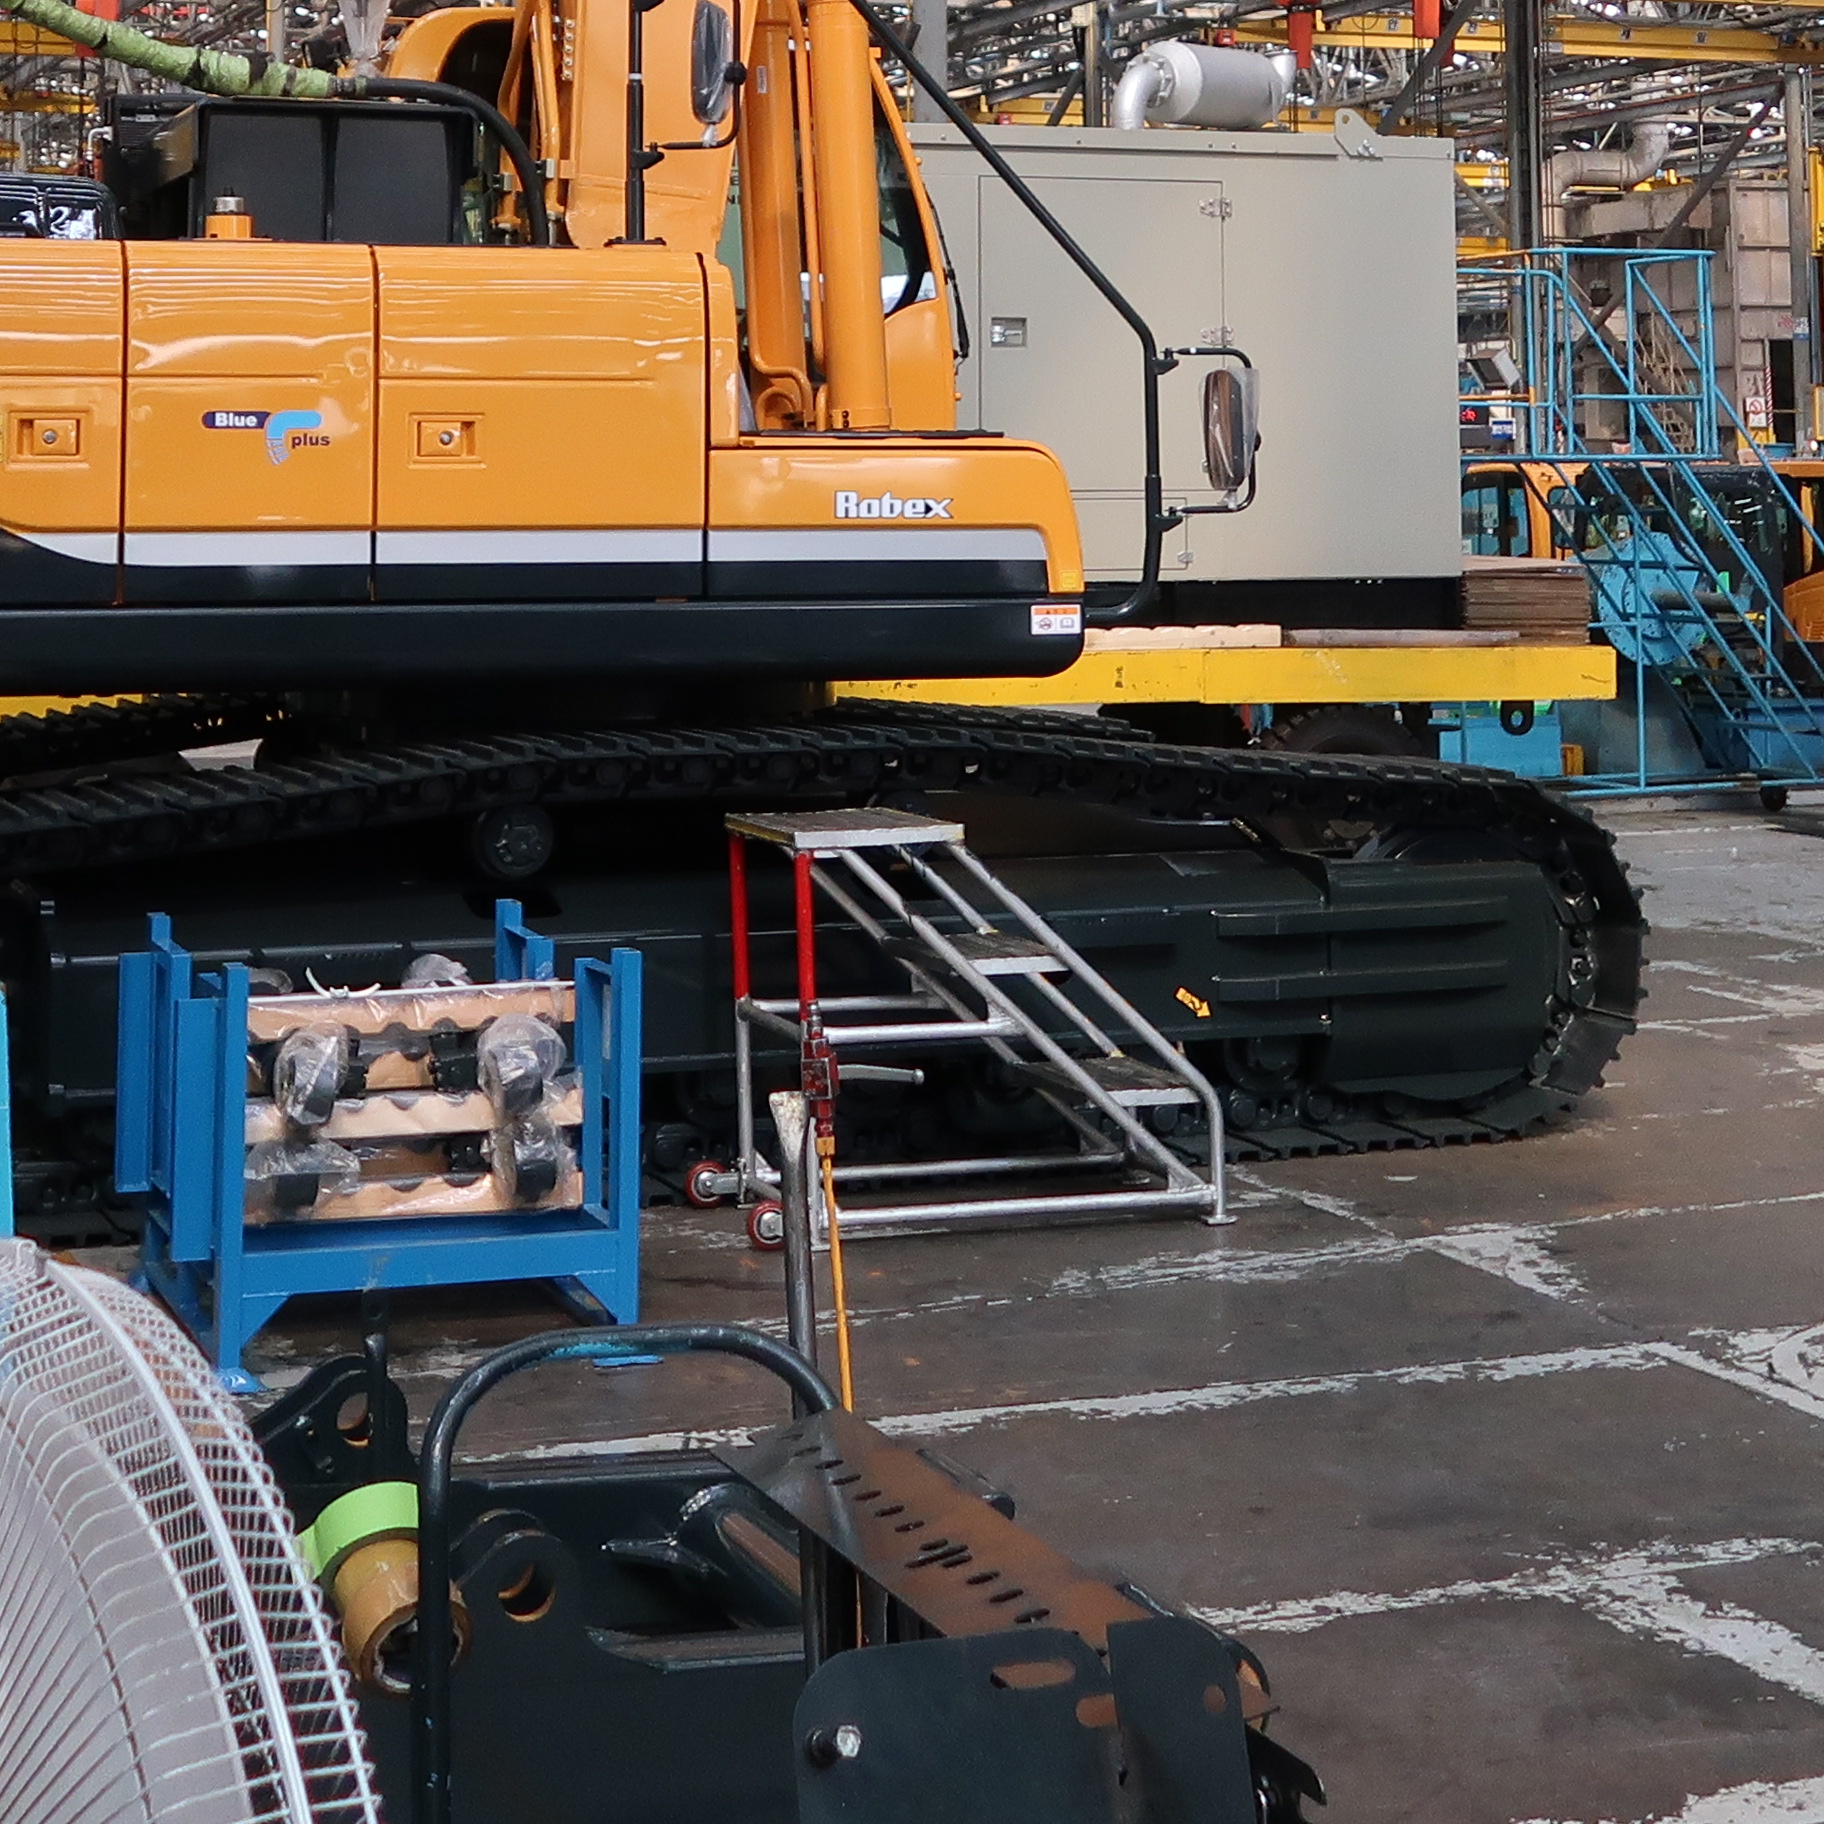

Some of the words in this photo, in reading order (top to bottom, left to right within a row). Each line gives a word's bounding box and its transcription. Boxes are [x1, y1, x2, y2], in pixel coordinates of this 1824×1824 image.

[214, 411, 258, 430] Blue
[290, 432, 331, 450] plus
[834, 490, 954, 520] Robex
